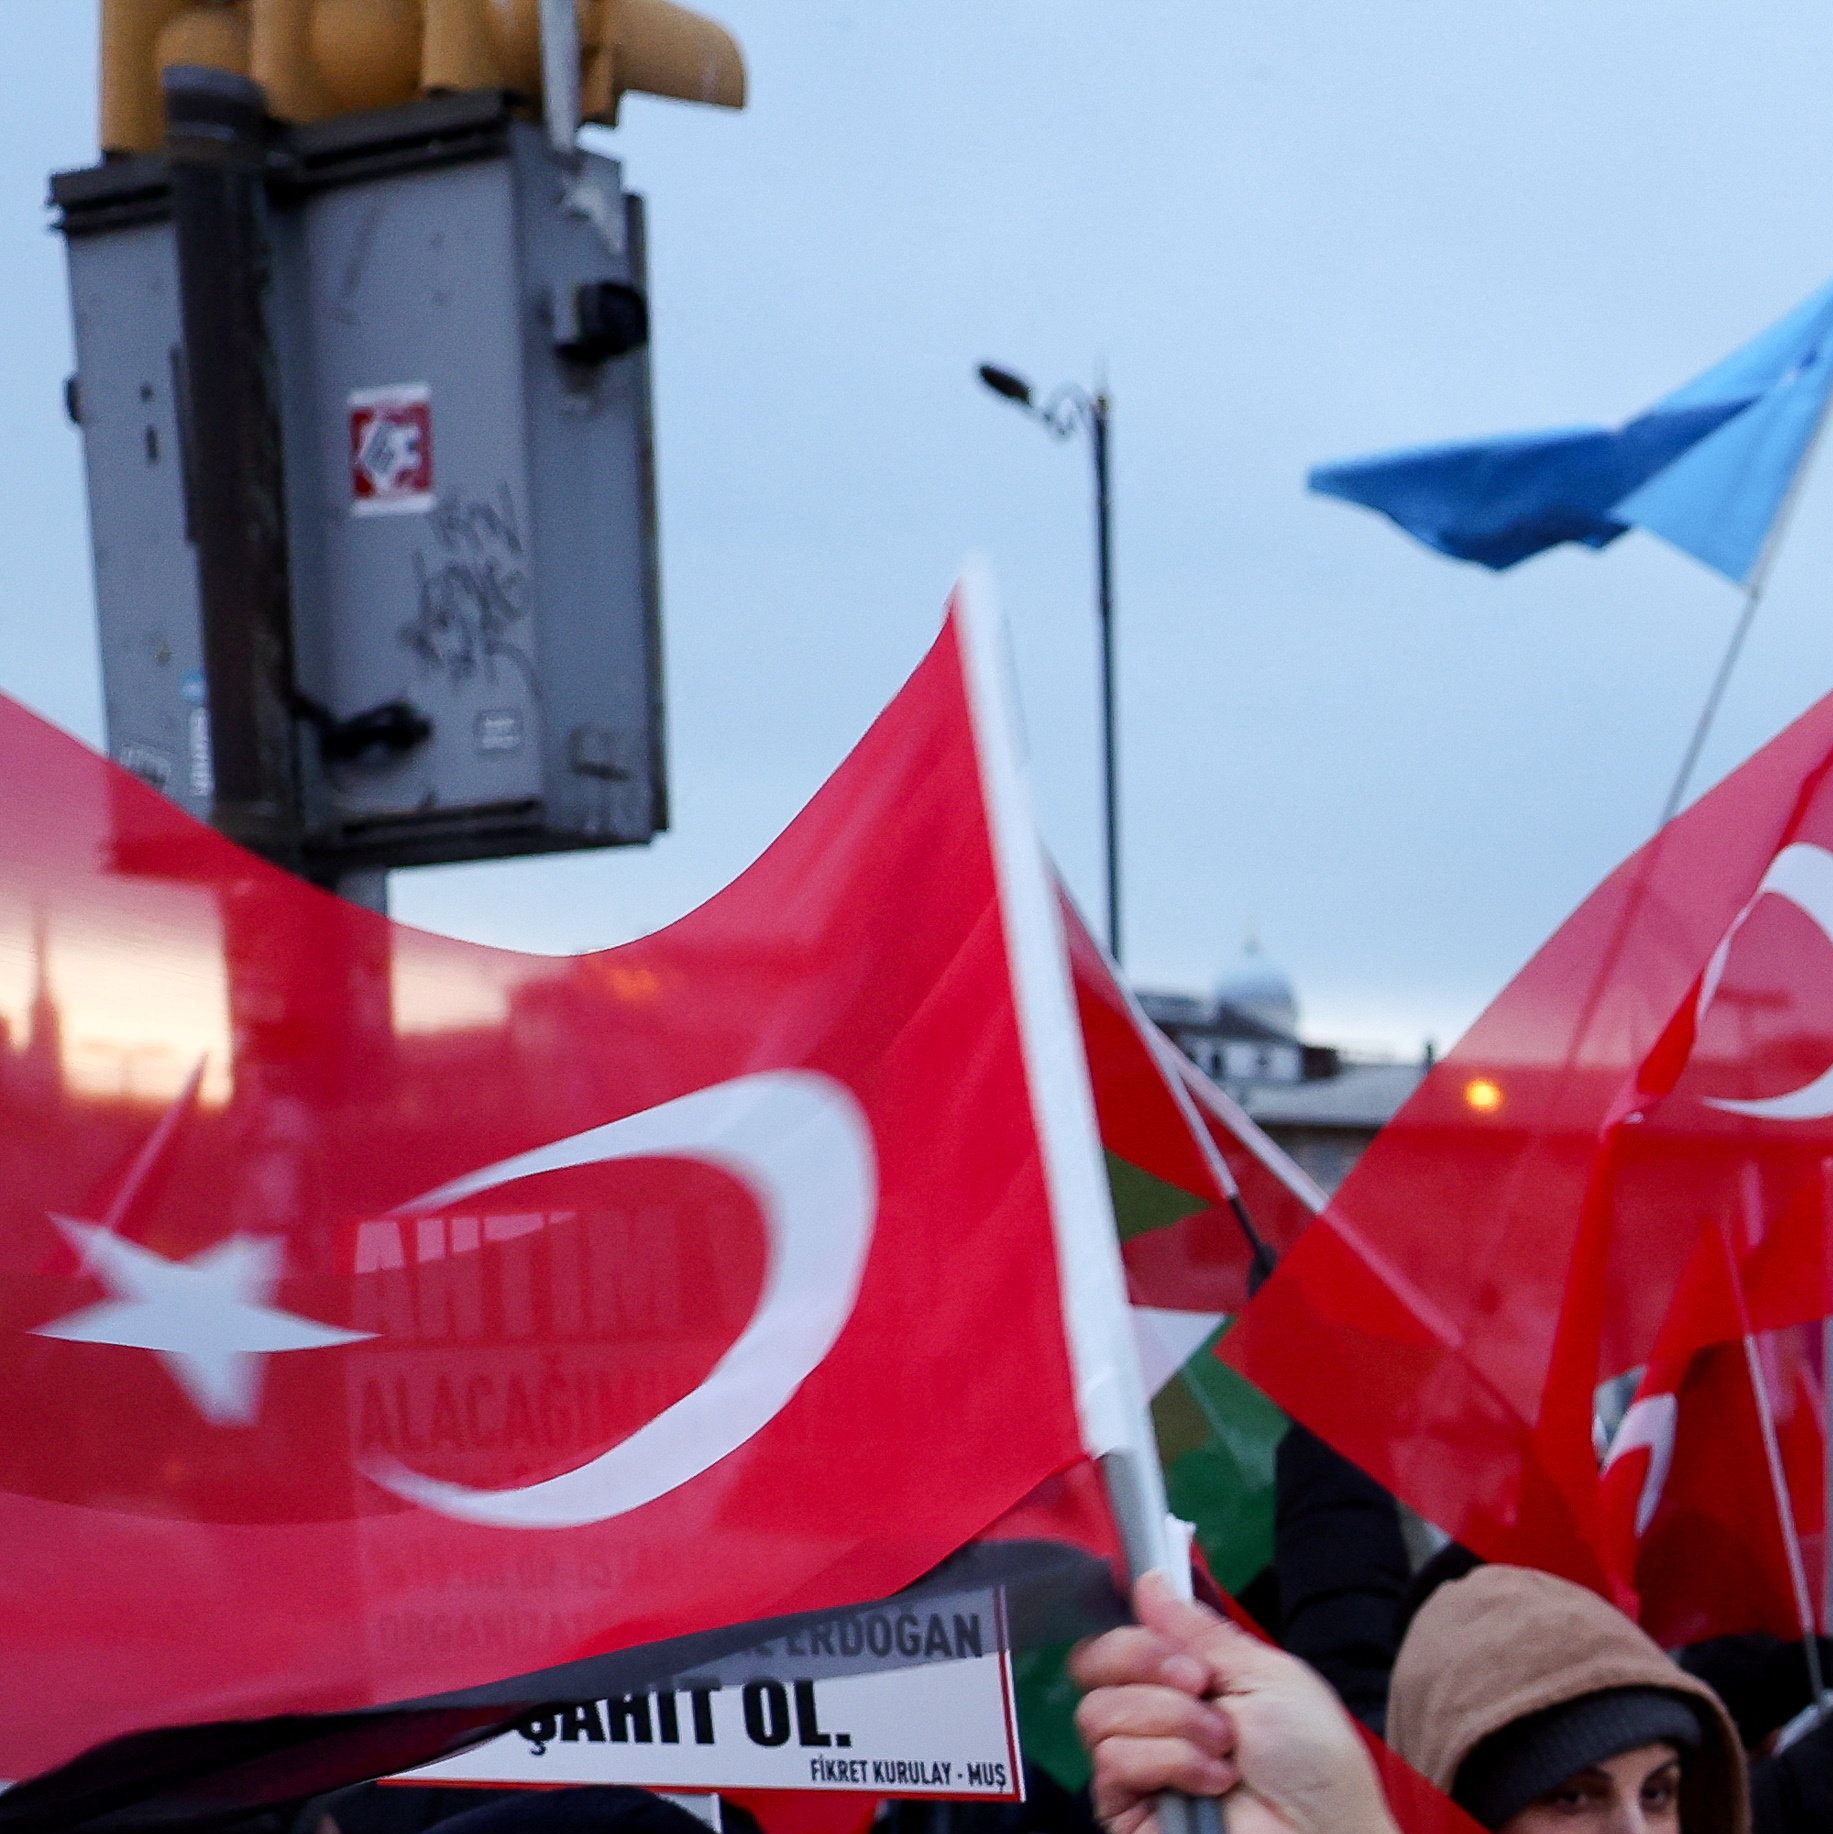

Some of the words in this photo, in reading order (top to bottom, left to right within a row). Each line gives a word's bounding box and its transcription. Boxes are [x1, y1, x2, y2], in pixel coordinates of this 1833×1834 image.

[787, 1604, 983, 1658] ERDOĞAN
[744, 1677, 851, 1747] OL.
[811, 1754, 867, 1783] FİKRET
[873, 1760, 951, 1785] KURULAY
[967, 1762, 1006, 1793] MUŞ
